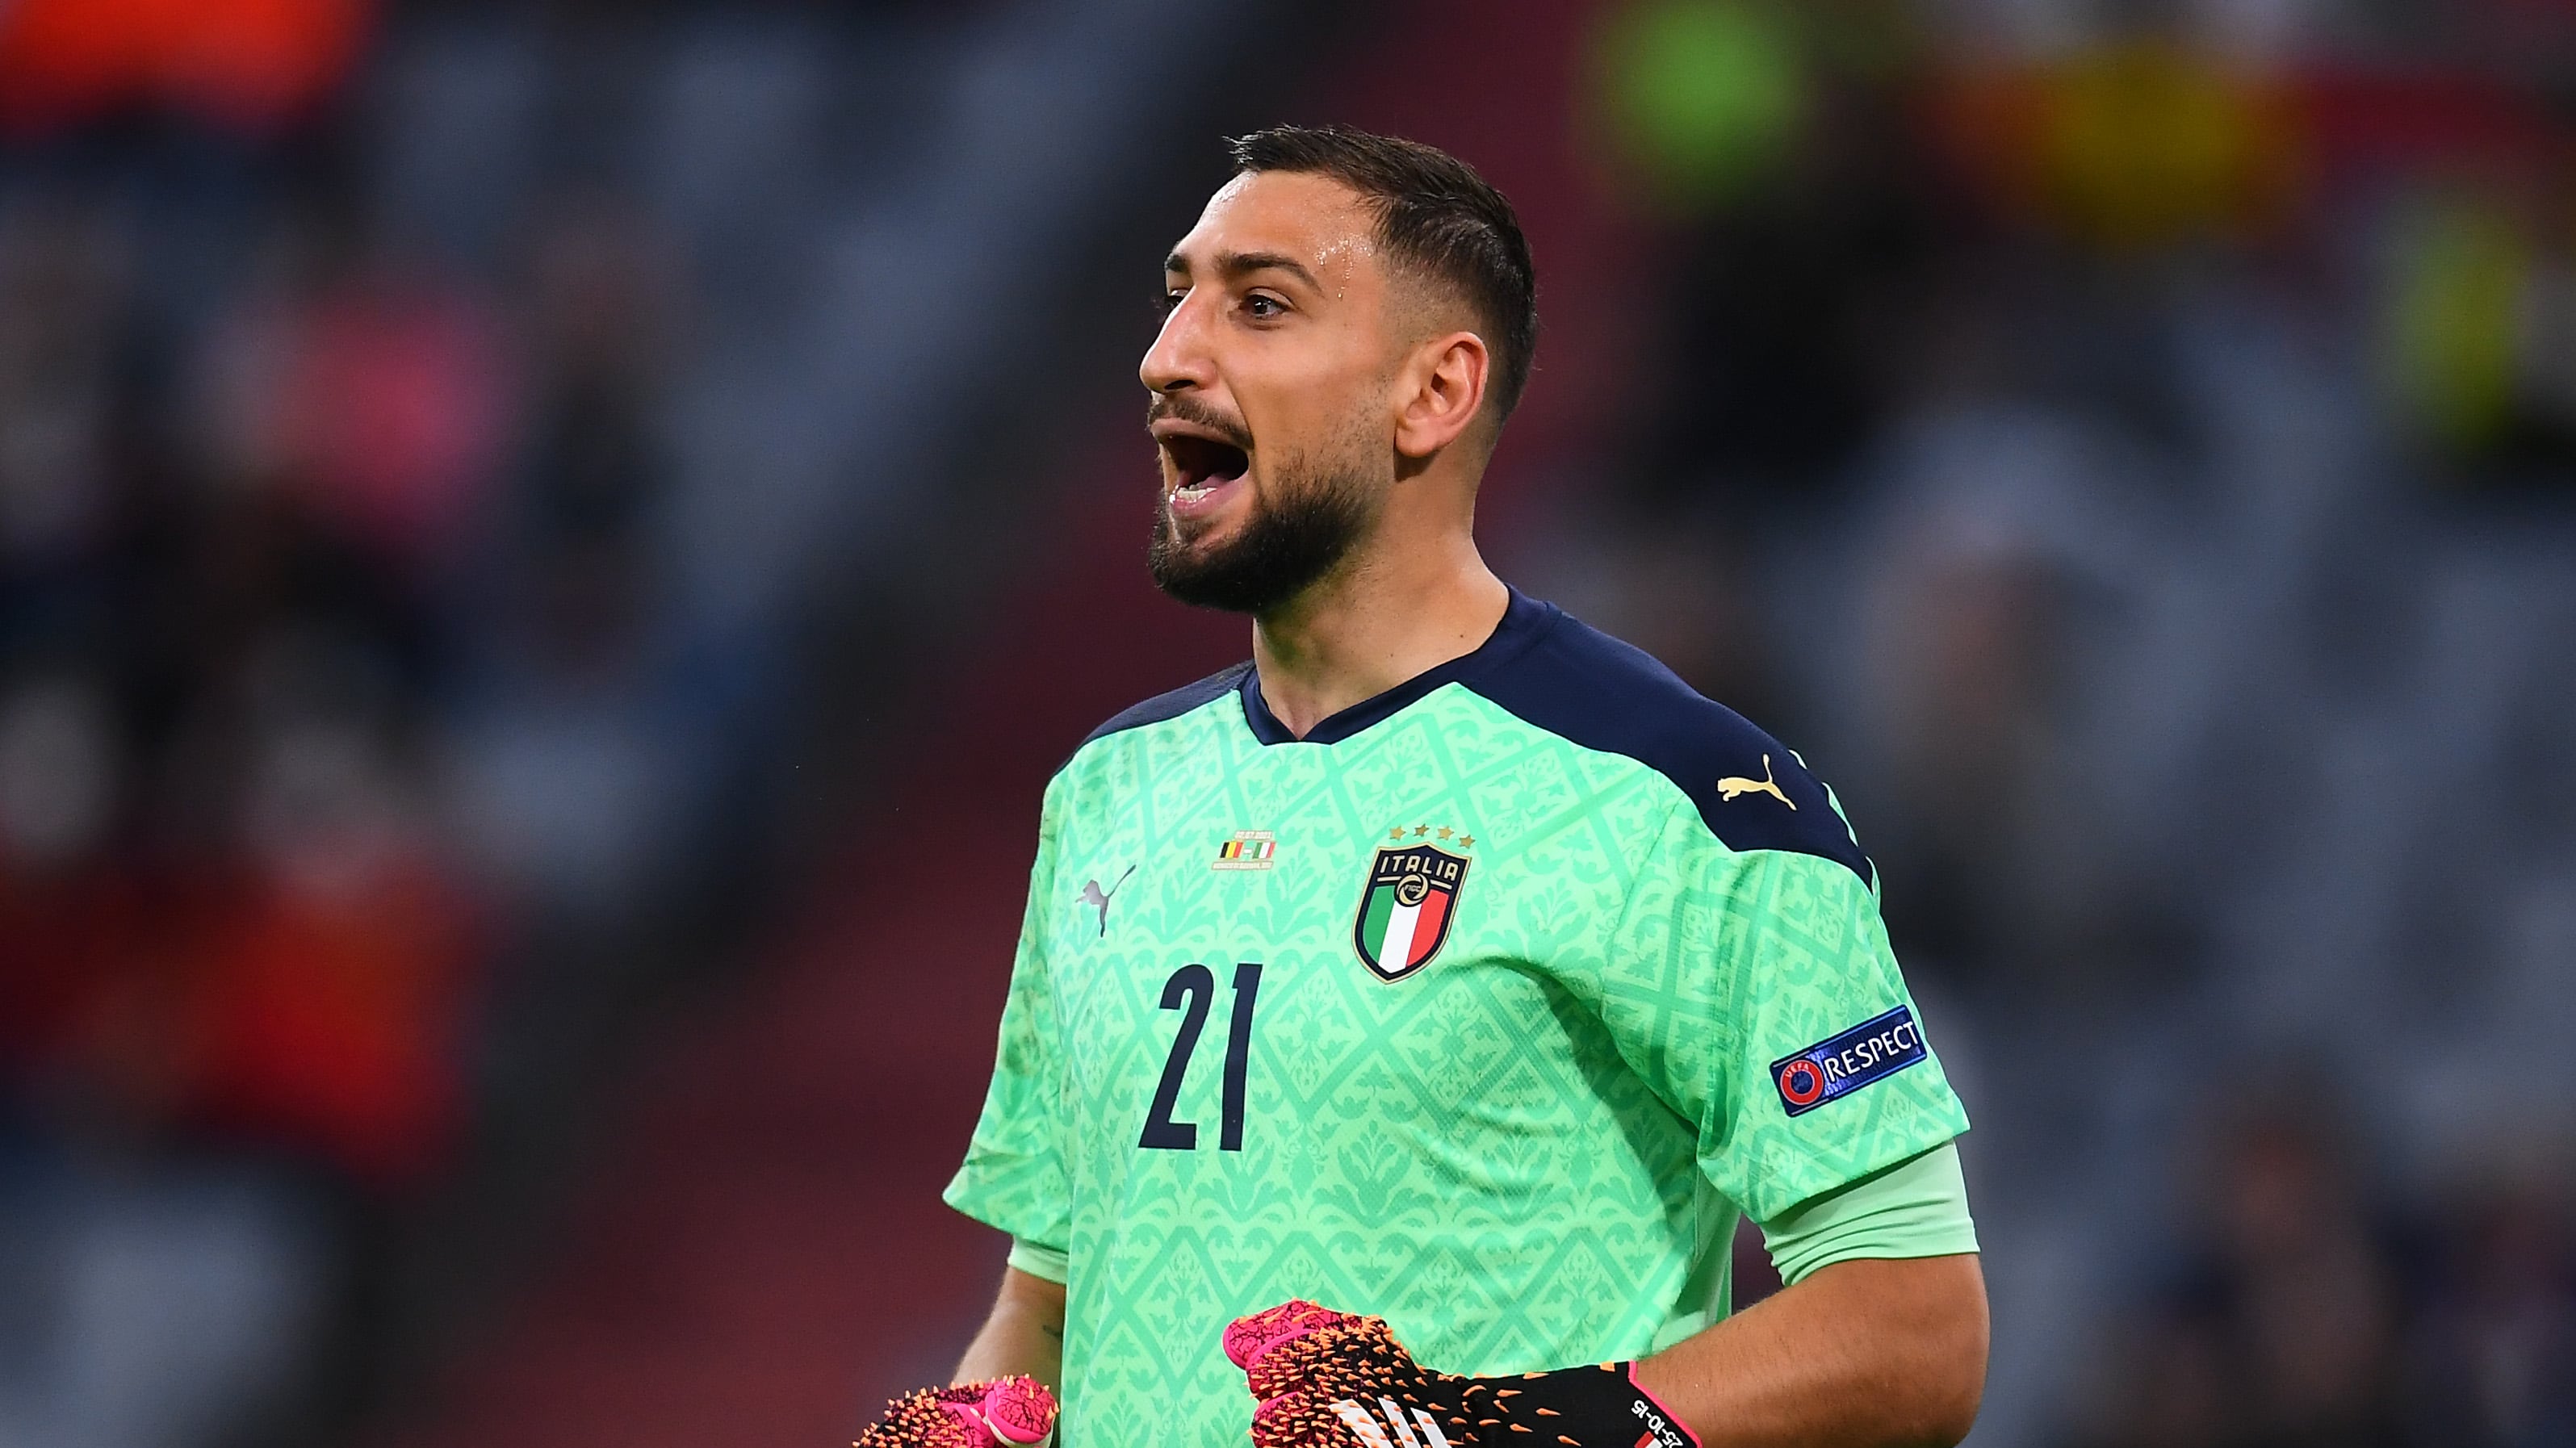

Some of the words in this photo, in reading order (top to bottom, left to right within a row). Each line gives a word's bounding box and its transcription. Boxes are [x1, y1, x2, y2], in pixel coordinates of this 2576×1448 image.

[1380, 855, 1459, 881] ITALIA
[1137, 963, 1263, 1152] 21
[1785, 1062, 1810, 1078] UEFA
[1824, 1021, 1918, 1082] RESPECT
